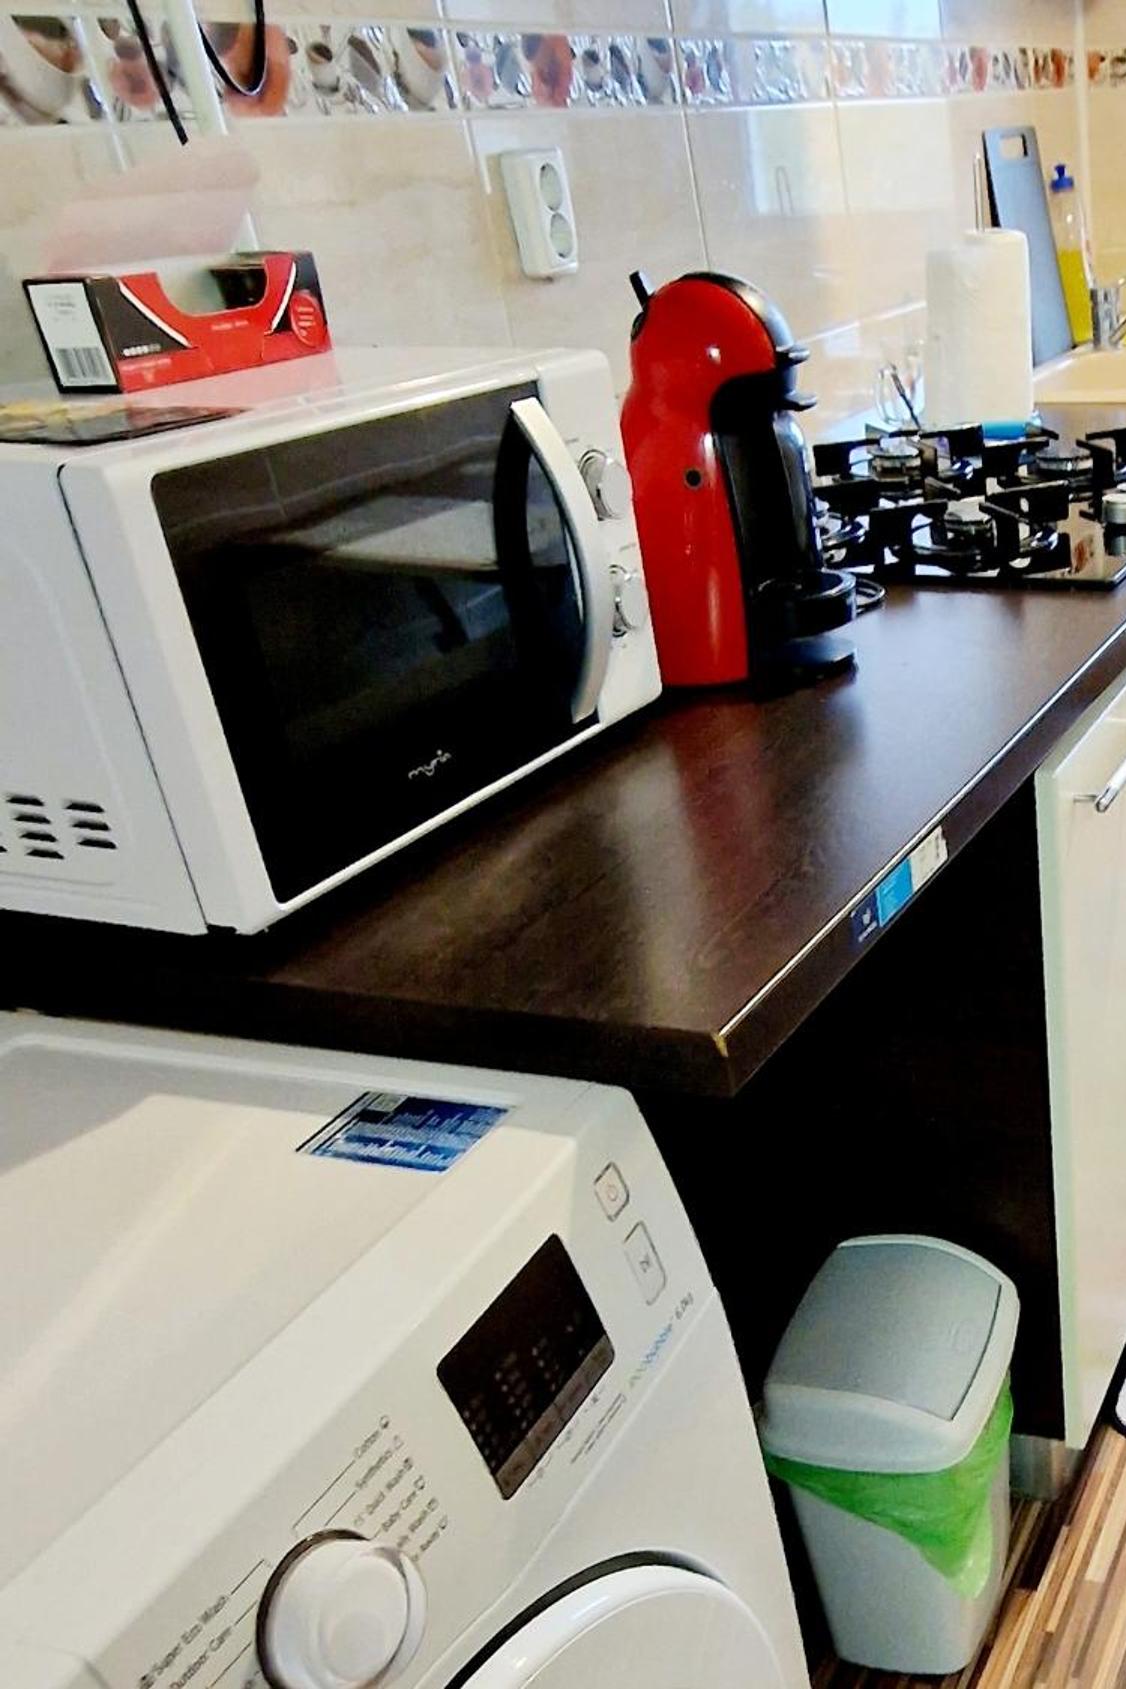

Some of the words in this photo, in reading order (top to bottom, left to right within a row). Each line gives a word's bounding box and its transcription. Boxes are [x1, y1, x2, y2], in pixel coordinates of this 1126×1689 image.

[153, 1642, 182, 1675] Super
[181, 1623, 203, 1646] Eco
[169, 1650, 210, 1689] Outdoor
[209, 1626, 233, 1652] Care
